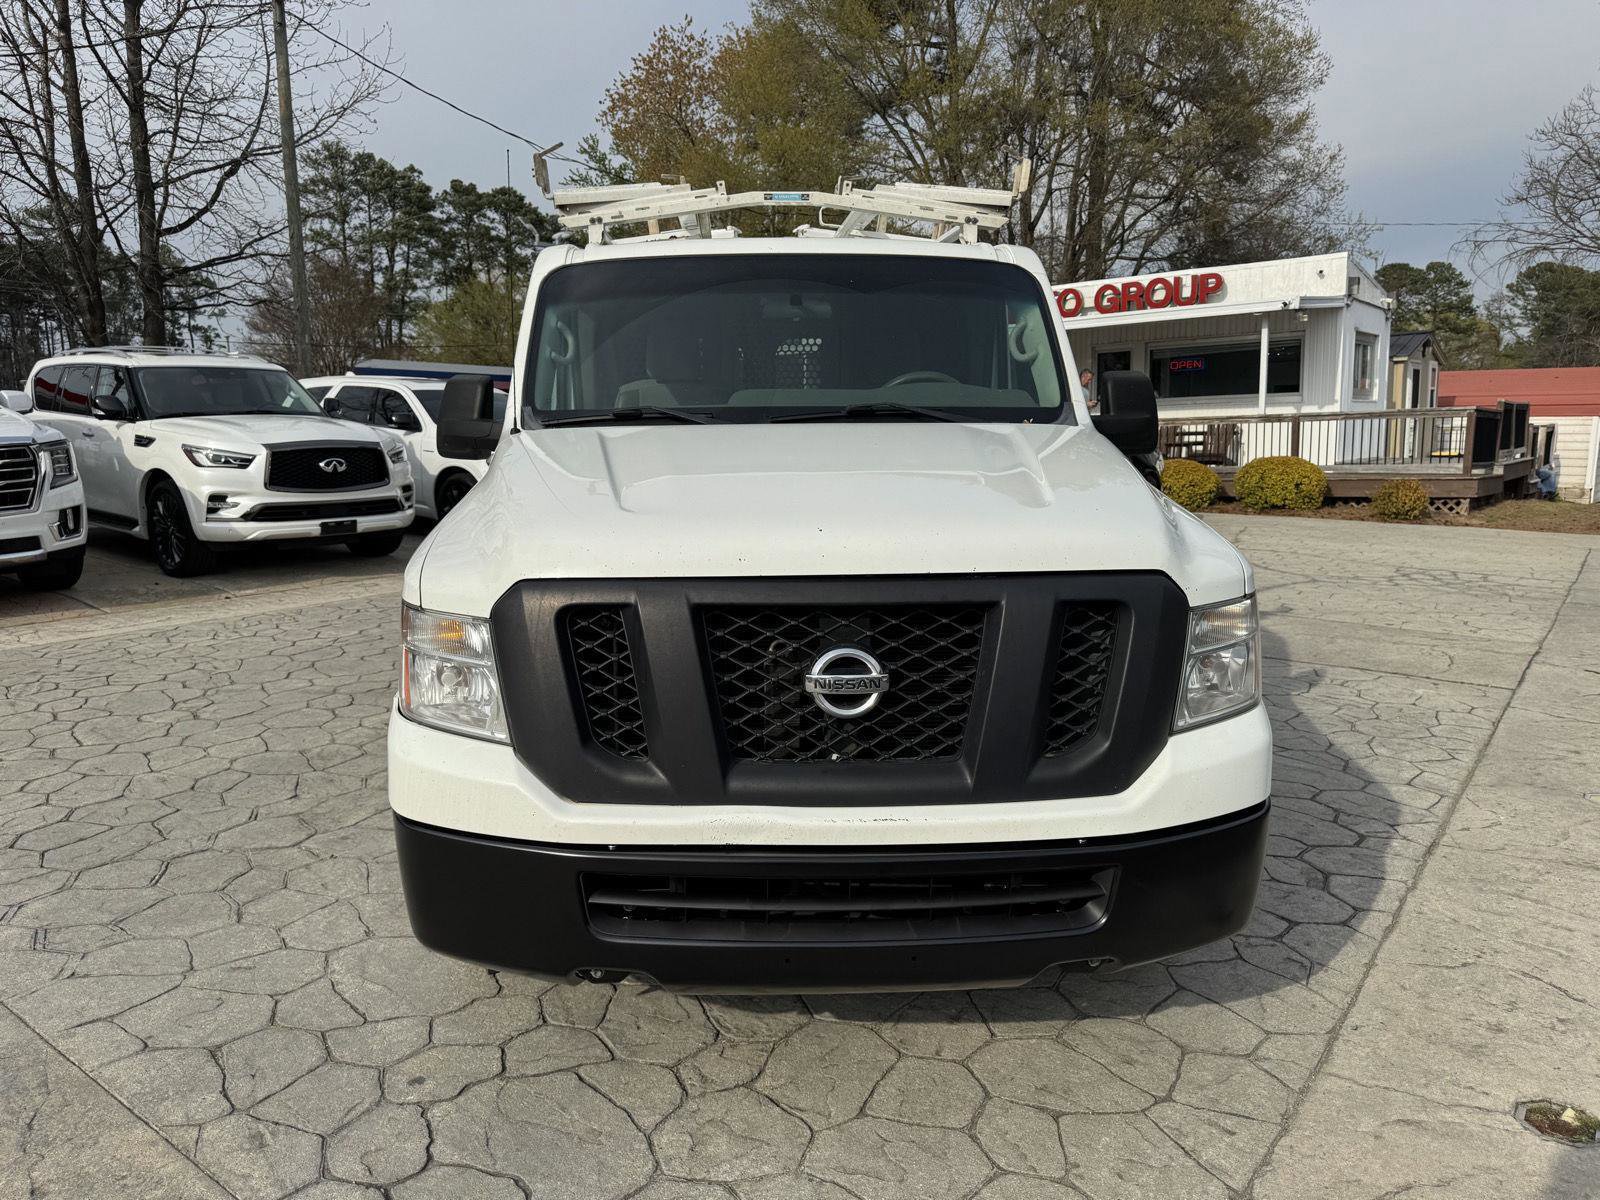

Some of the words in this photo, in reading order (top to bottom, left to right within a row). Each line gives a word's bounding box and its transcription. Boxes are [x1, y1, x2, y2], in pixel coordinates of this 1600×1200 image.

[1053, 288, 1083, 318] O
[1094, 273, 1224, 314] GROUP
[1170, 360, 1202, 370] OPEN
[813, 678, 881, 690] NISSAN
